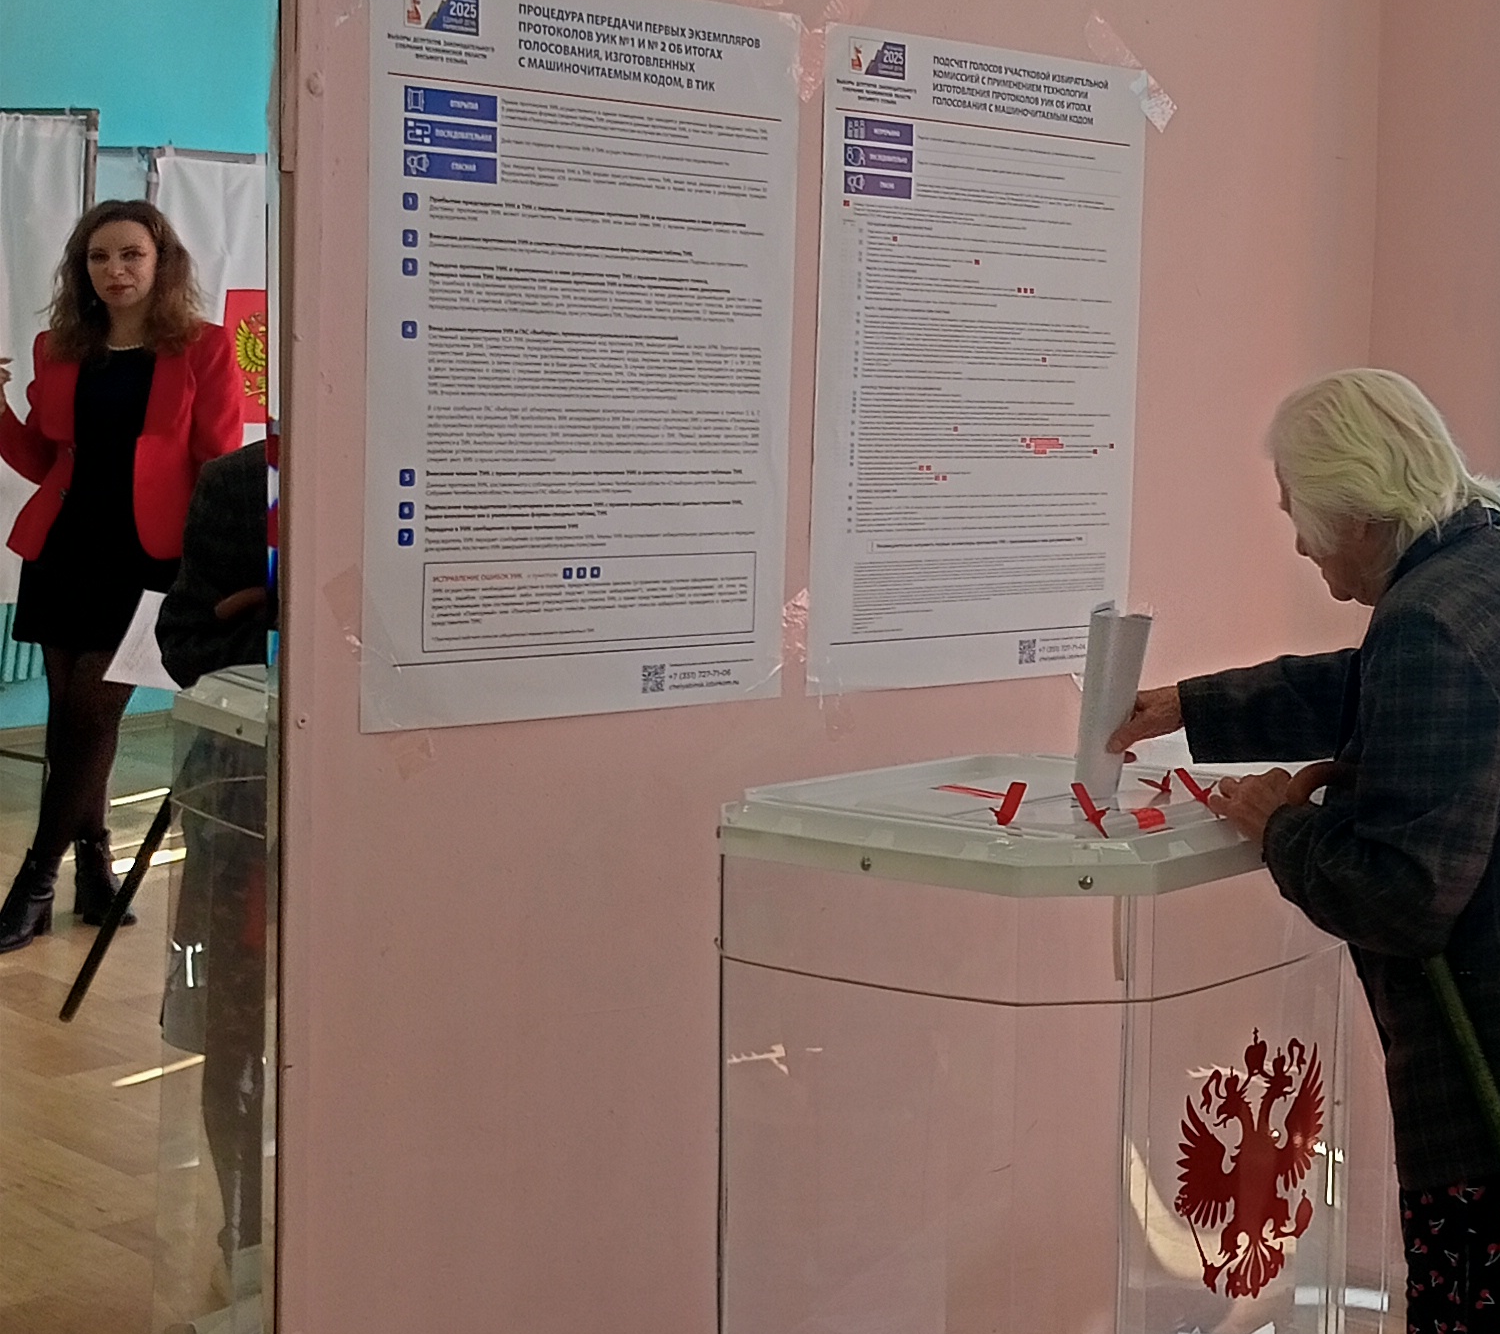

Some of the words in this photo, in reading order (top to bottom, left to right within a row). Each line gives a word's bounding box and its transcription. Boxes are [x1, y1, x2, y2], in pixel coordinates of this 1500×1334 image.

[450, 1, 476, 18] 2025
[519, 3, 584, 23] ПРОЦЕДУРА
[587, 14, 642, 31] ПЕРЕДАЧИ
[645, 22, 686, 38] ПЕРВЫХ
[689, 28, 760, 48] ЭКЗЕМПЛЯРОВ
[519, 21, 593, 42] ПРОТОКОЛОВ
[596, 33, 616, 44] УИК
[638, 39, 645, 49] И
[669, 43, 682, 54] ОБ
[685, 45, 722, 59] ИТОГАХ
[519, 39, 602, 61] ГОЛОСОВАНИЯ,
[605, 51, 695, 72] ИЗГОТОВЛЕННЫХ
[883, 50, 903, 65] 2025
[519, 57, 526, 67] С
[528, 58, 641, 82] МАШИНОЧИТАЕМЫМ
[643, 70, 684, 88] КОДОМ,
[687, 78, 693, 88] В
[695, 79, 715, 92] ТИК
[933, 56, 968, 69] ПОДСЧЕТ
[969, 60, 1002, 74] ГОЛОСОВ
[1004, 66, 1050, 81] УЧАСТКОВОЙ
[1052, 73, 1109, 90] ИЗБИРАТЕЛЬНОЙ
[933, 70, 980, 85] КОМИССИЕЙ
[981, 76, 986, 85] С
[987, 77, 1041, 92] ПРИМЕНЕНИЕМ
[1043, 85, 1088, 99] ТЕХНОЛОГИИ
[932, 83, 990, 99] ИЗГОТОВЛЕНИЯ
[992, 91, 1040, 105] ПРОТОКОЛОВ
[1041, 98, 1054, 107] УИК
[1056, 100, 1065, 109] ОБ
[1066, 101, 1092, 112] ИТОГАХ
[932, 96, 987, 111] ГОЛОСОВАНИЯ
[989, 104, 993, 112] С
[995, 105, 1068, 122] МАШИНОЧИТАЕМЫМ
[1069, 114, 1094, 125] КОДОМ
